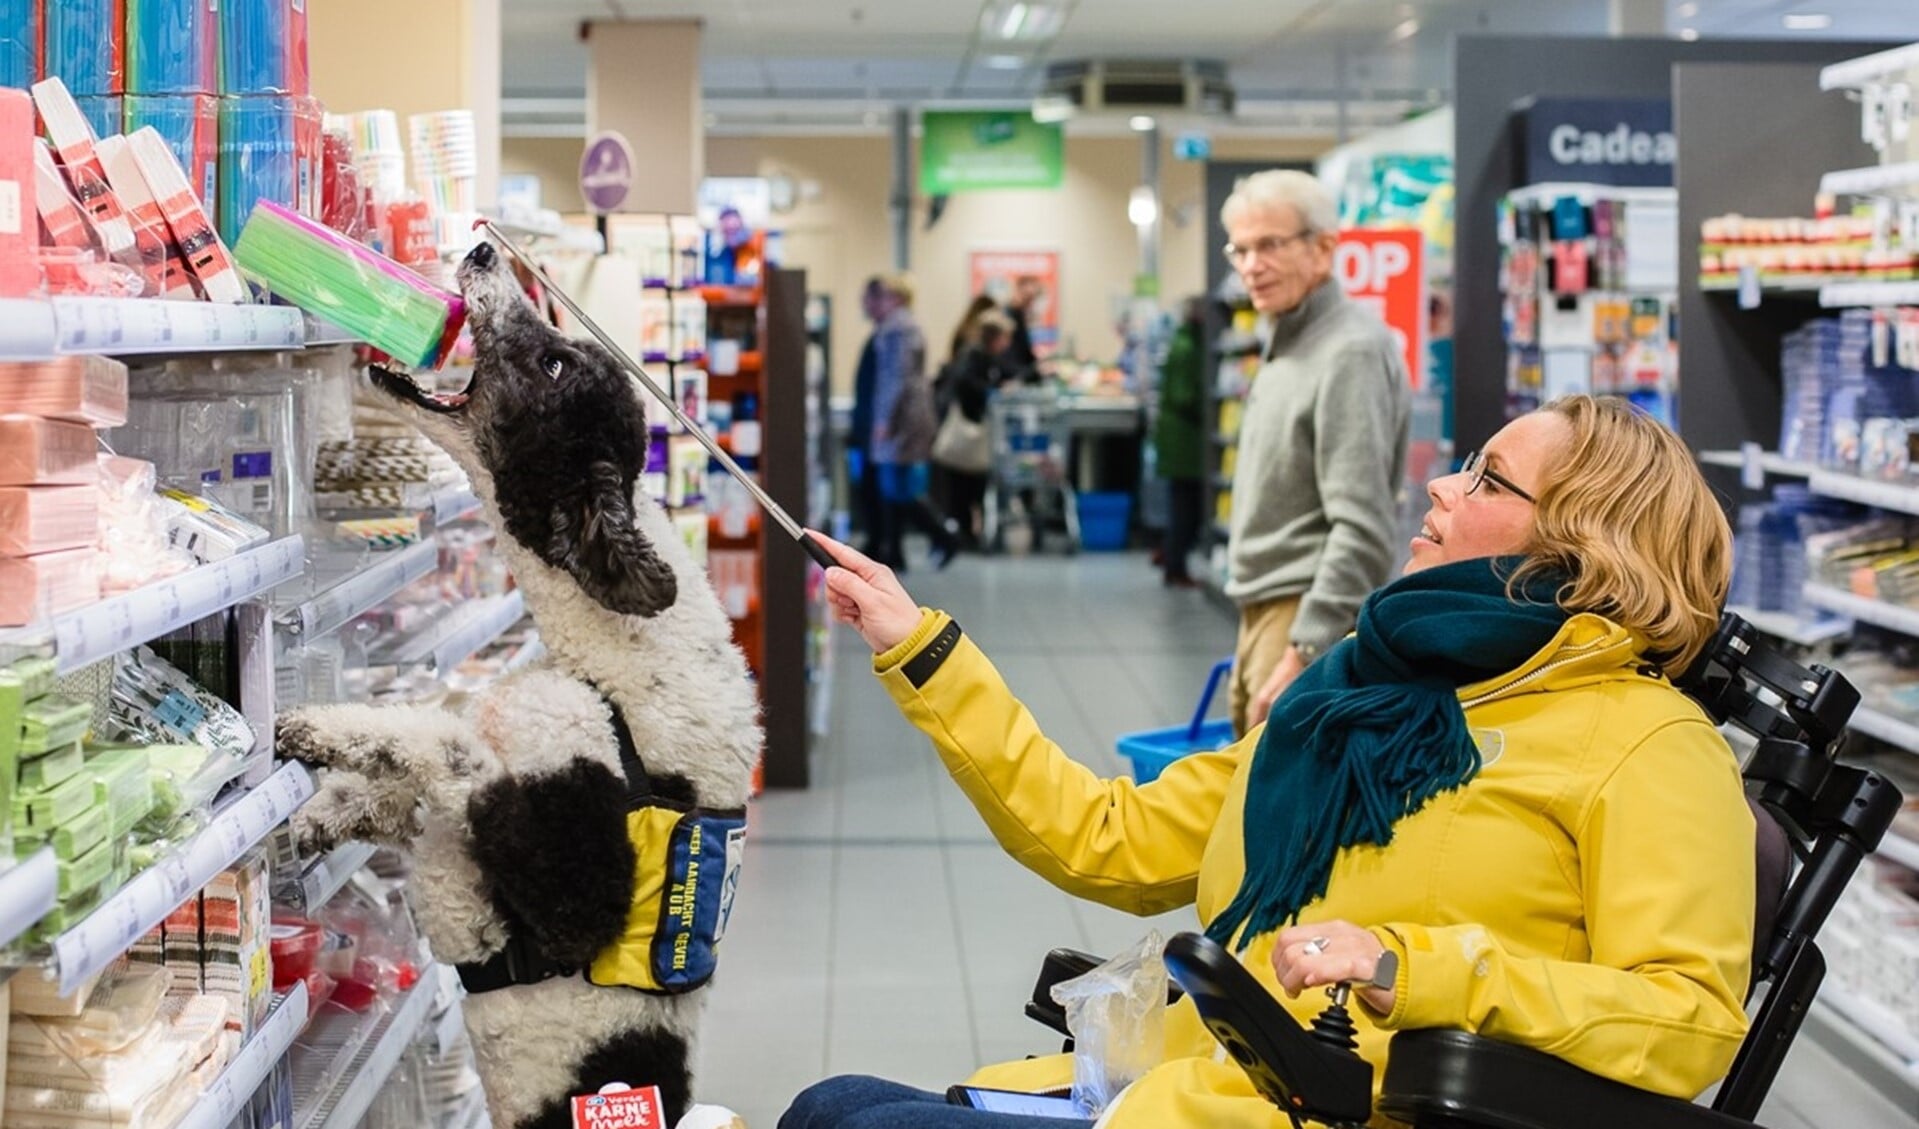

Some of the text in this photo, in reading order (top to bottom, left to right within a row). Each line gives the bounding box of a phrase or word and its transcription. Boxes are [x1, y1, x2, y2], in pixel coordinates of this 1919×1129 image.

[669, 883, 685, 915] AUB
[672, 825, 701, 970] GEEN AANDACHT GEVEN
[584, 1101, 651, 1121] KARNE
